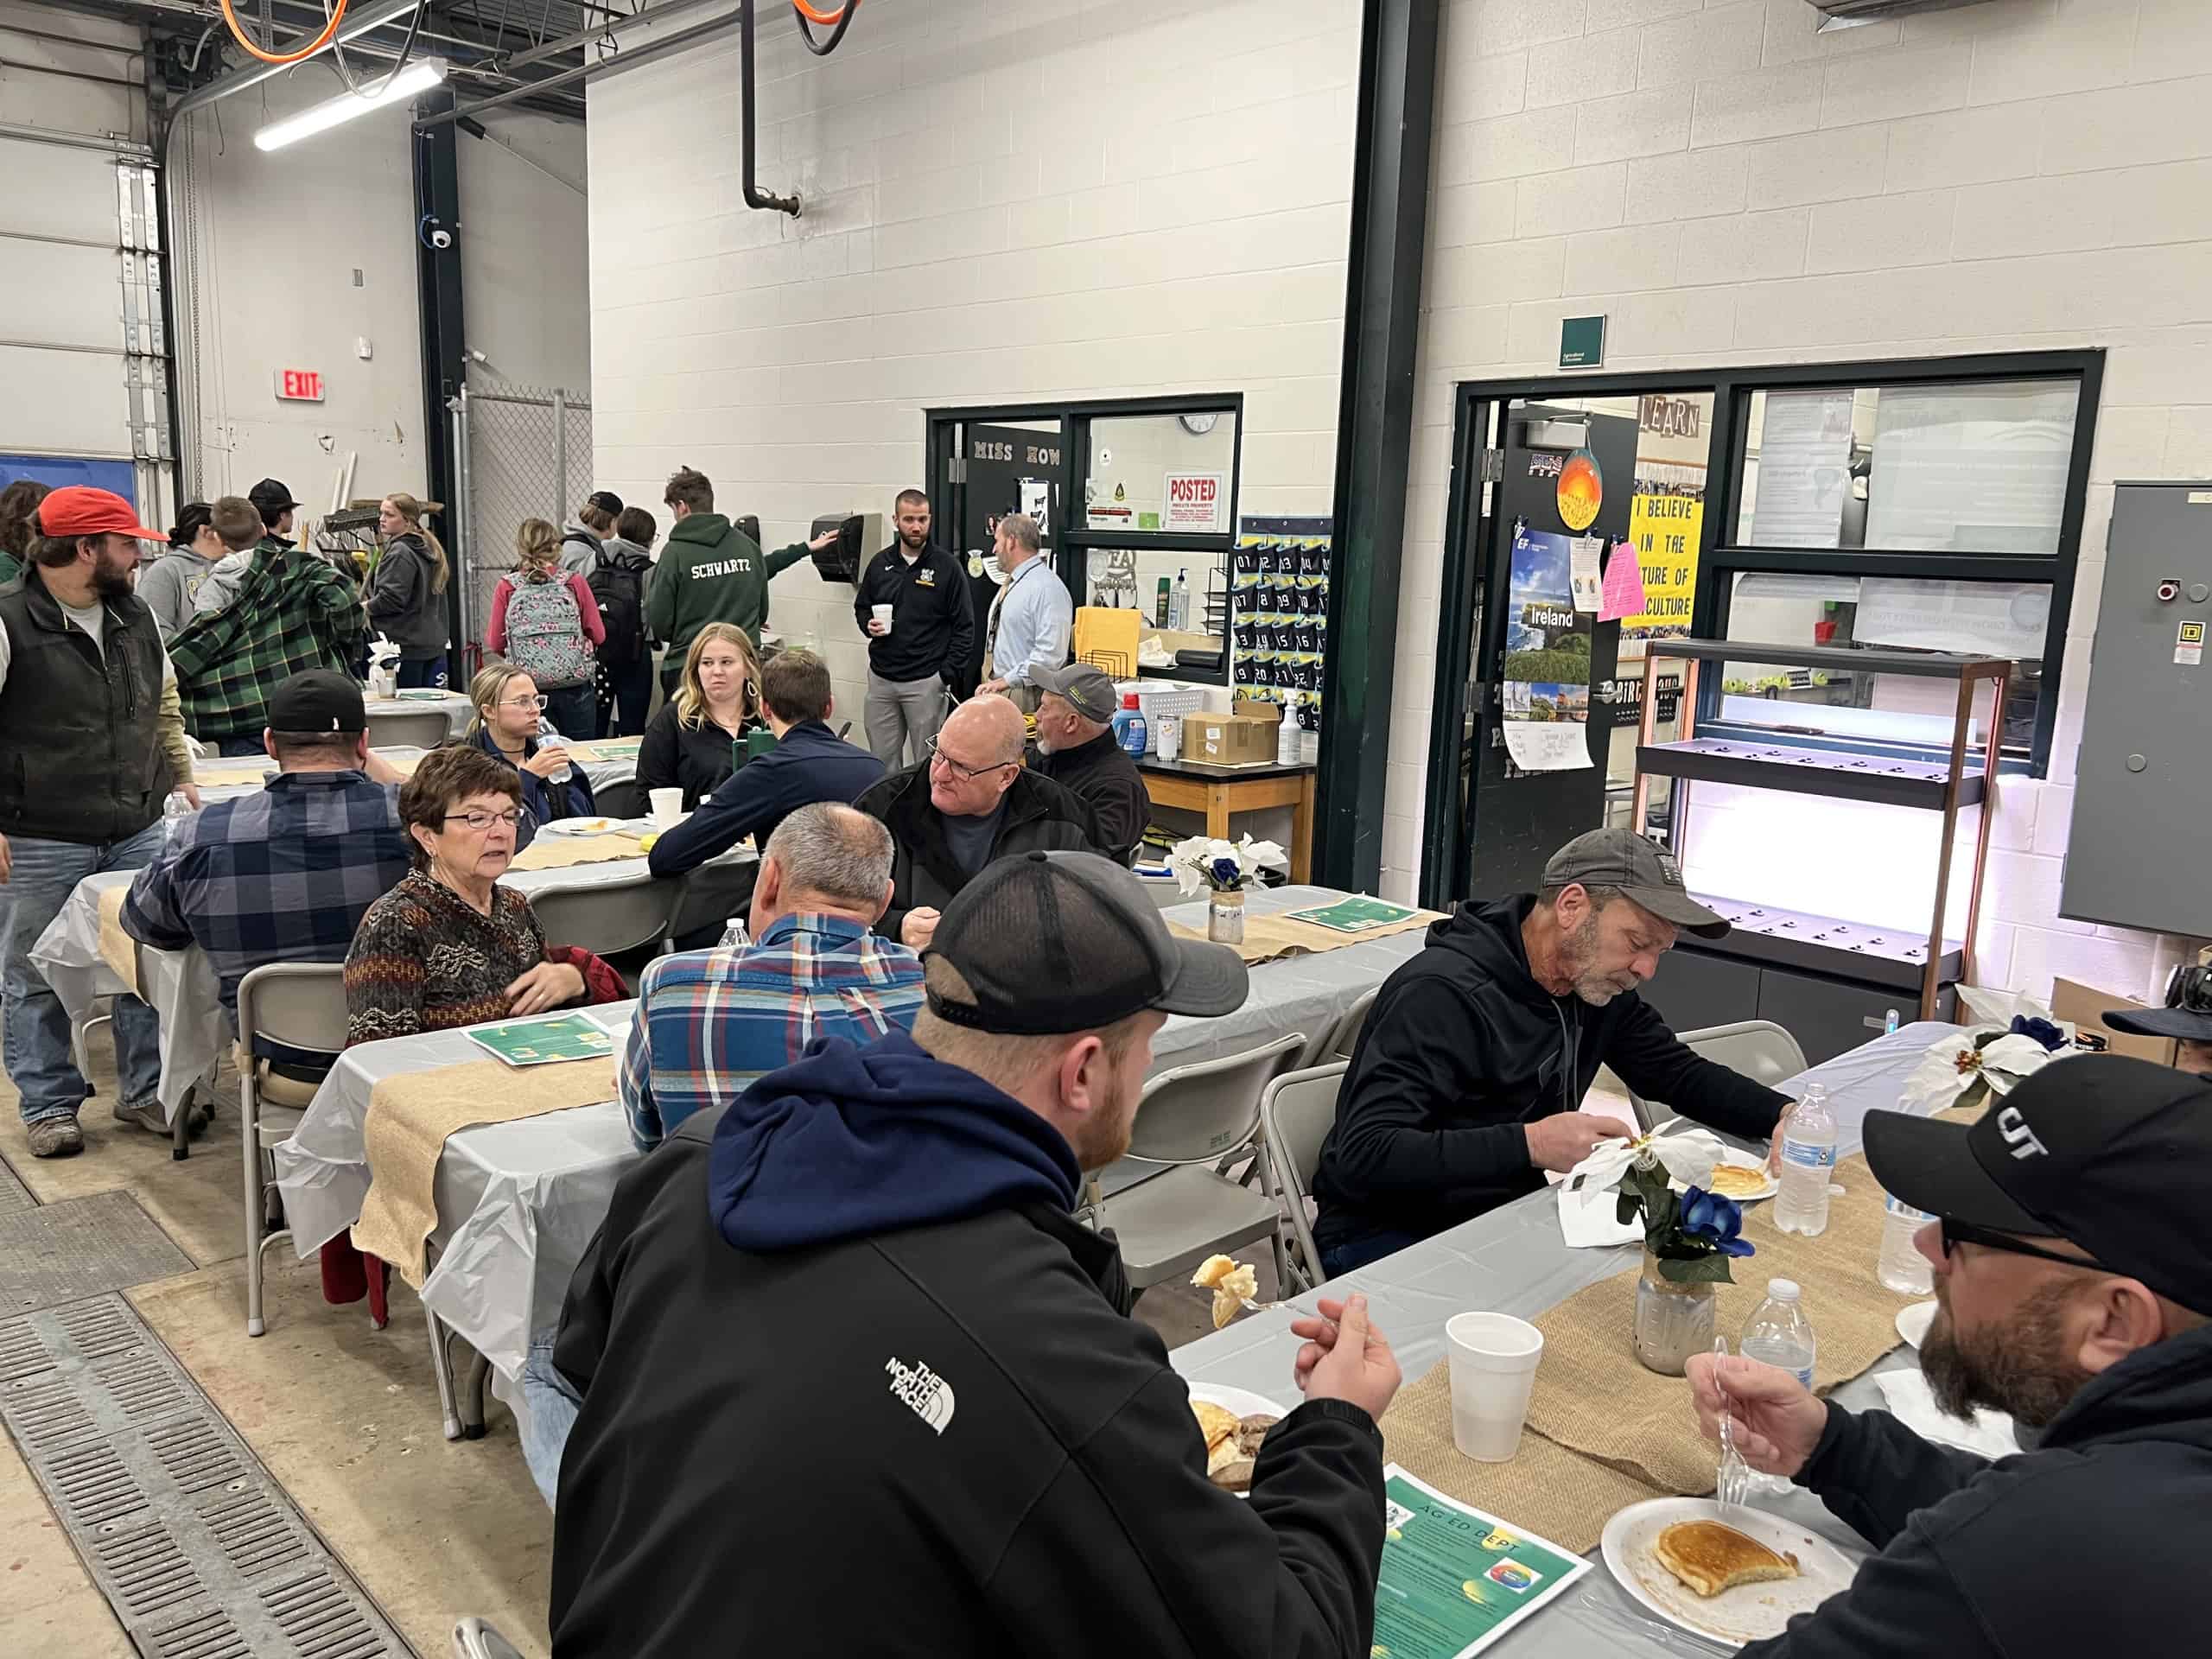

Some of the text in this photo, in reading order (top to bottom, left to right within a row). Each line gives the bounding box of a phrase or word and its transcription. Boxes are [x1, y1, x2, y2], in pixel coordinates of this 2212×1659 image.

[284, 370, 319, 398] EXIT
[1639, 397, 1700, 436] LEARN
[974, 441, 1013, 461] MISS
[1171, 479, 1216, 501] POSTED
[1637, 499, 1693, 518] I BELIEVE
[1640, 533, 1654, 552] IN
[691, 558, 752, 580] SCHWARTZ
[1638, 566, 1688, 586] TURE OF
[1532, 606, 1573, 627] Ireland
[1637, 597, 1691, 616] CULTURE
[885, 1357, 936, 1402] NORTH
[915, 1360, 942, 1391] THE
[889, 1378, 925, 1413] FACE
[1419, 1504, 1444, 1520] AG
[1447, 1517, 1471, 1532] ED
[1474, 1529, 1522, 1553] DEPT
